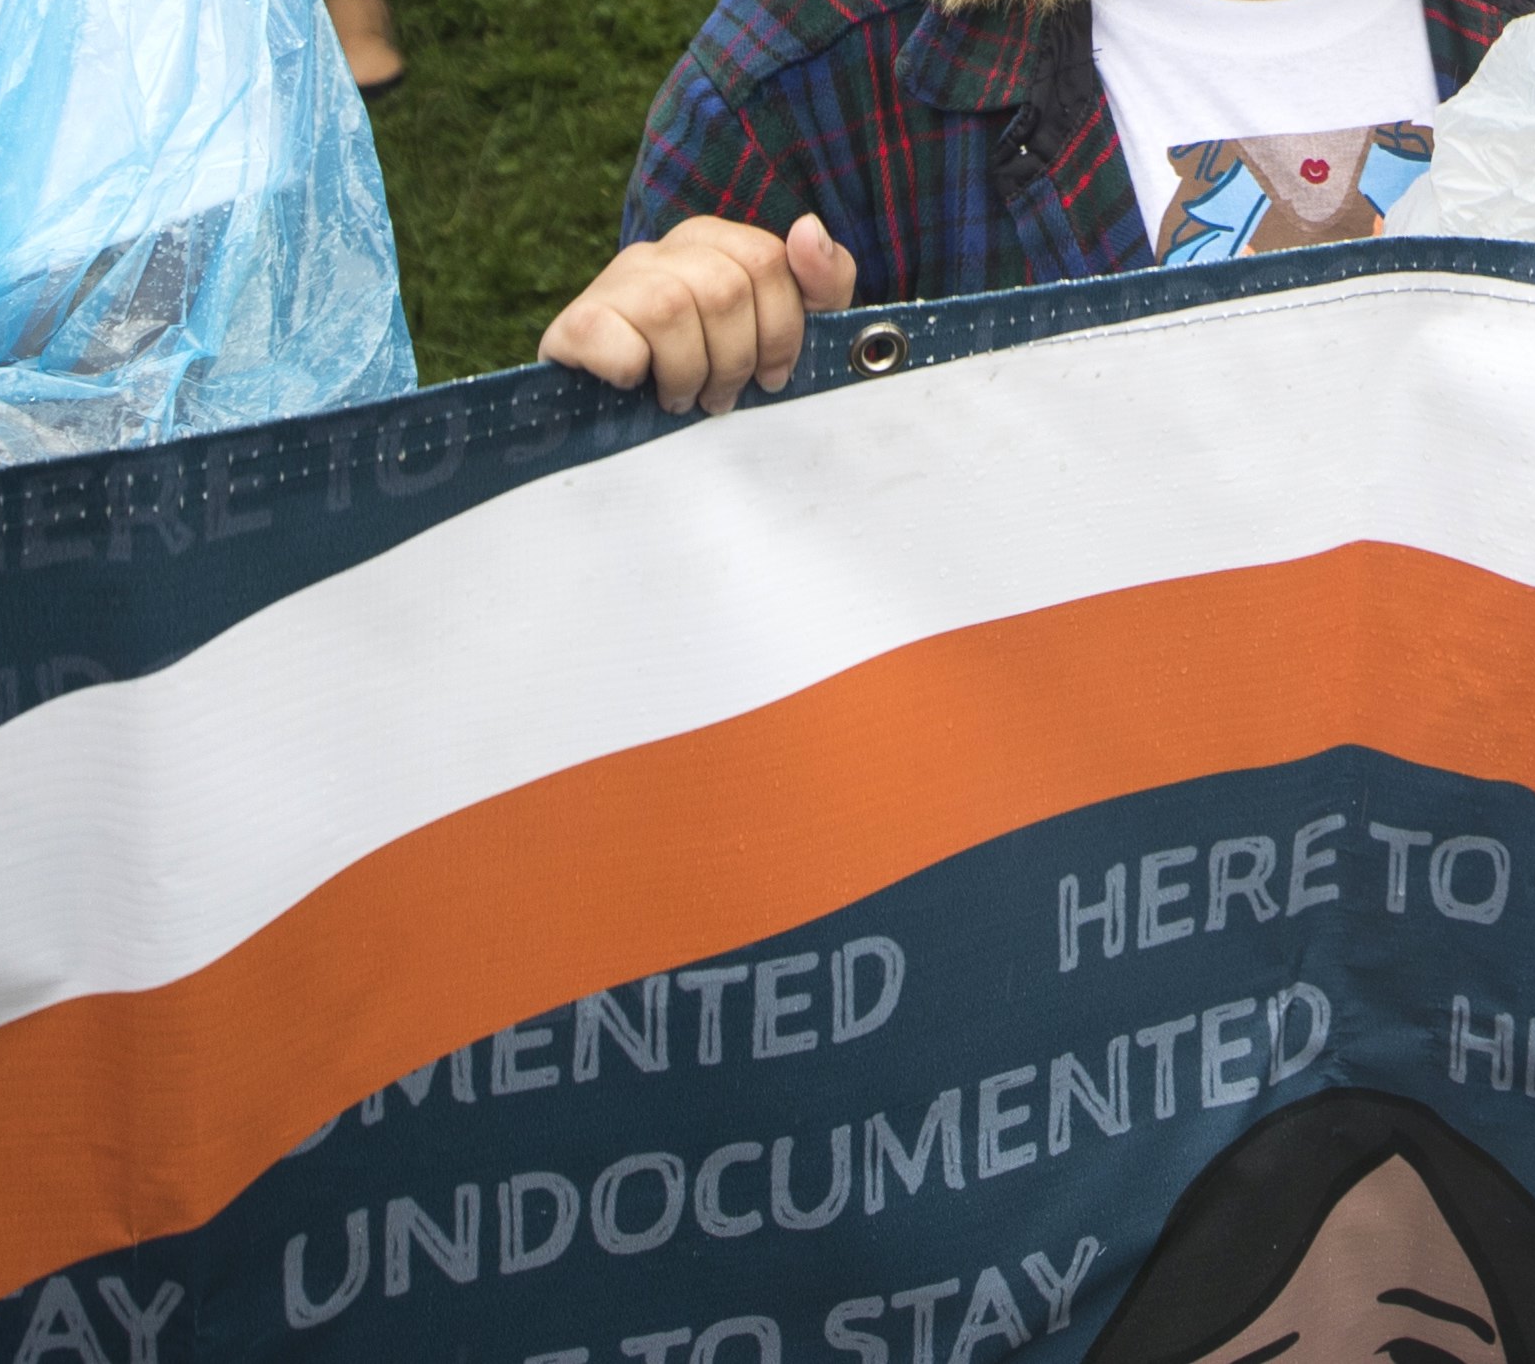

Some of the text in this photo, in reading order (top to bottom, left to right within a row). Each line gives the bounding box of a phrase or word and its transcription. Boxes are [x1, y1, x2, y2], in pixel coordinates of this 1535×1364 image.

[1057, 813, 1347, 973] HERE
[1369, 819, 1512, 924] TO
[284, 981, 1332, 1330] UNDOCUMENTED
